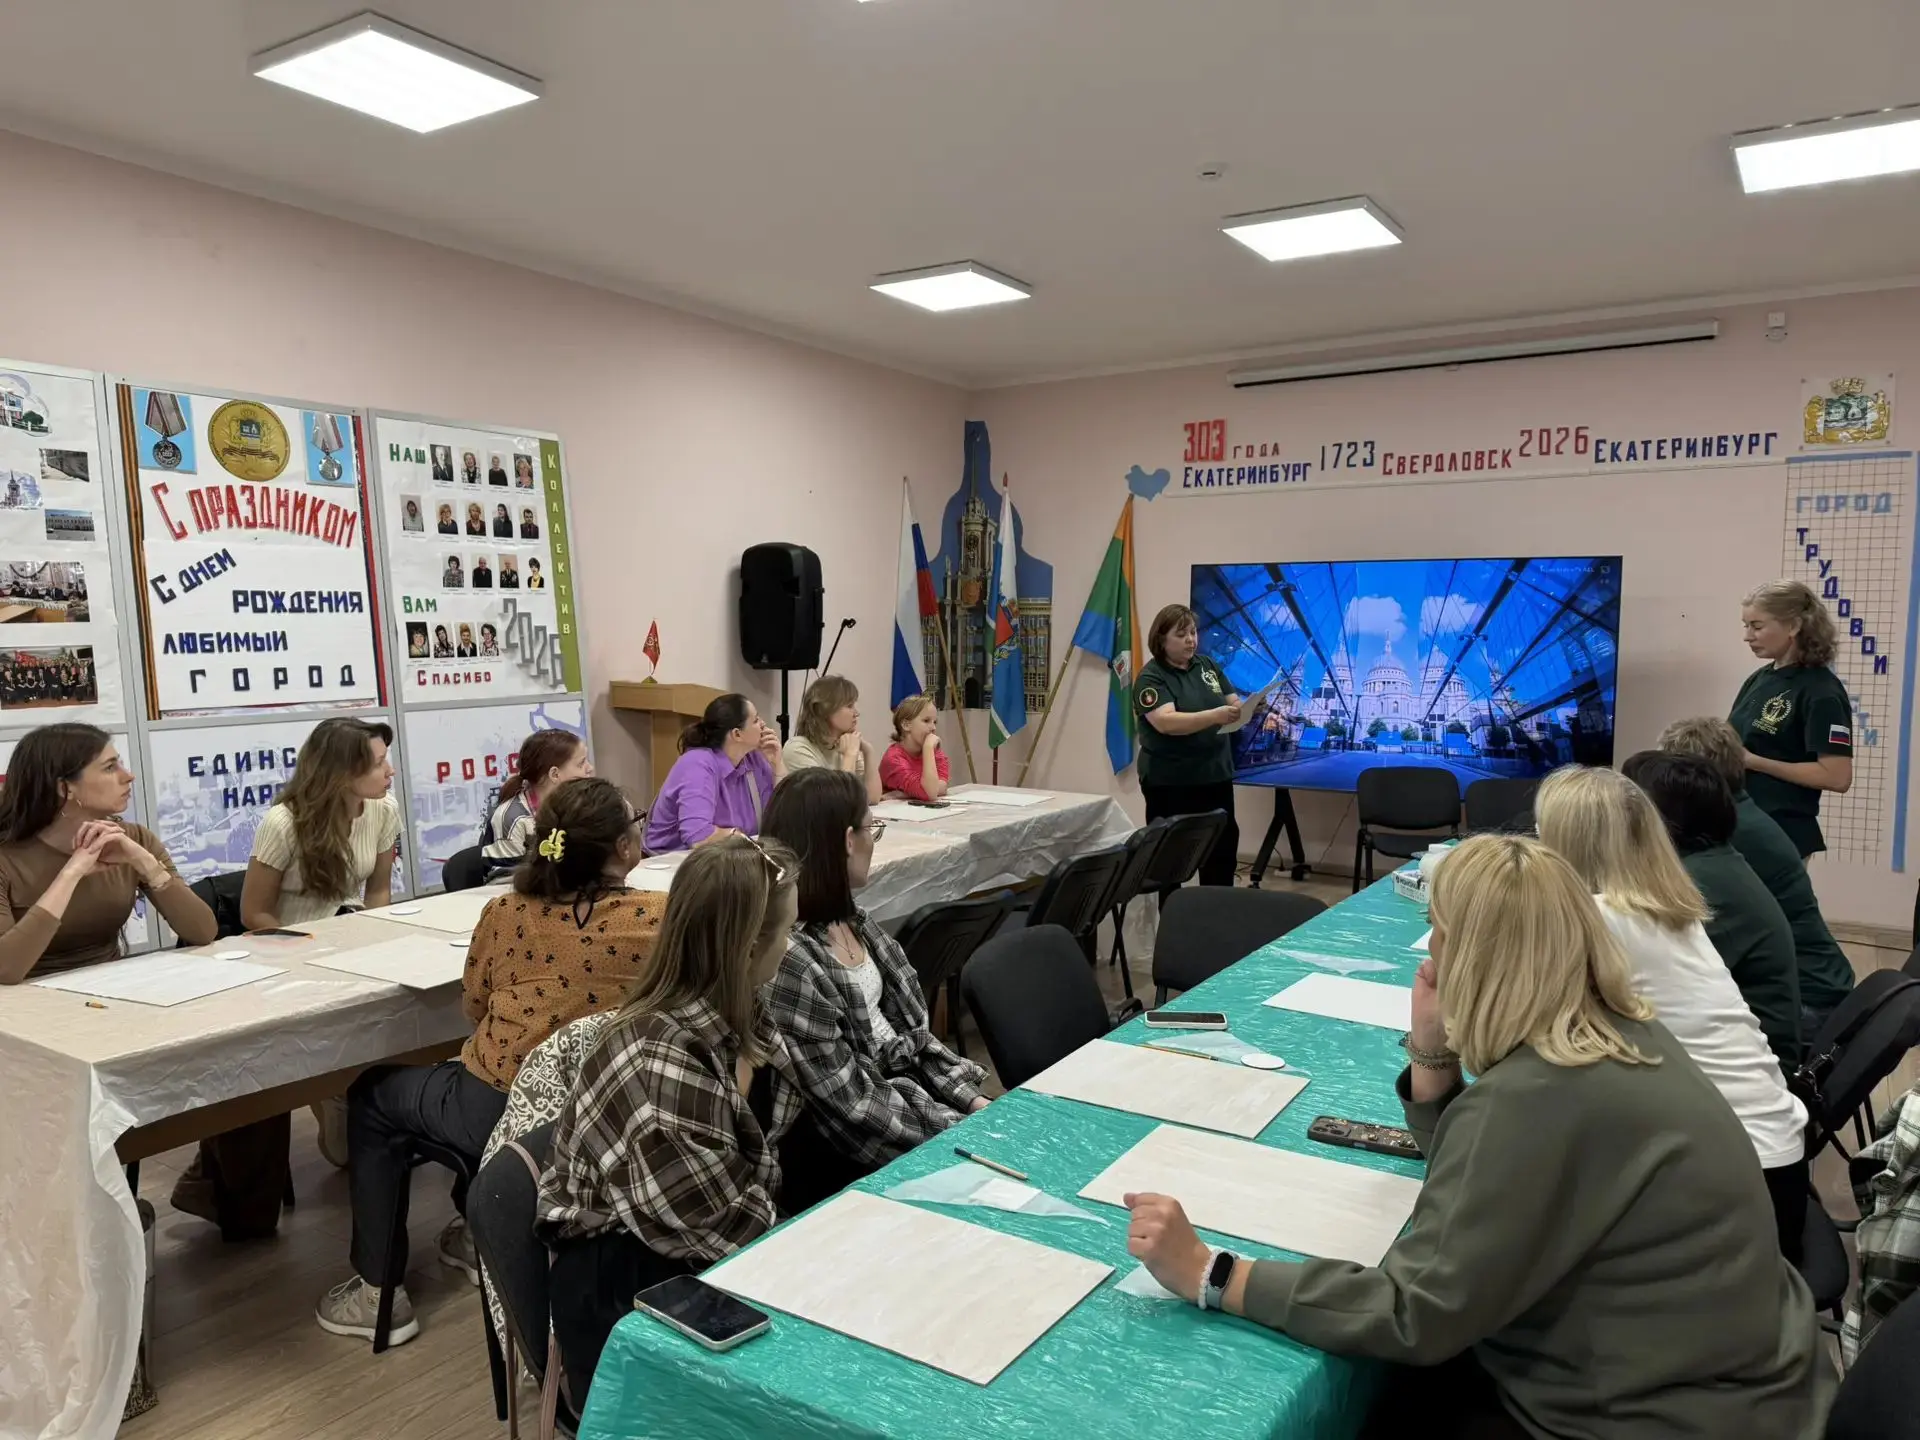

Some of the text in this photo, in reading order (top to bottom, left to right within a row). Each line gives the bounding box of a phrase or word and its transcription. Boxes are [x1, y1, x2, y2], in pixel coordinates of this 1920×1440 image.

[389, 443, 426, 464] НАШ
[1183, 419, 1280, 463] 303 ГОДА
[1321, 441, 1376, 471] 1723
[1519, 426, 1589, 457] 2026
[150, 482, 358, 549] С ПРАЗДНИКОМ
[1796, 492, 1892, 514] ГОРОД
[547, 454, 571, 635] КОЛЛЕКТИВ
[150, 548, 237, 605] С ДНЕМ
[232, 590, 364, 614] РОЖДЕНИЯ
[402, 595, 437, 614] ВАМ
[503, 597, 565, 686] 2026
[190, 664, 356, 693] ГОРОД
[417, 670, 493, 686] СПАСИБО
[188, 747, 297, 777] ЕДИНС
[436, 752, 521, 784] РОСС
[223, 783, 285, 809] НАР
